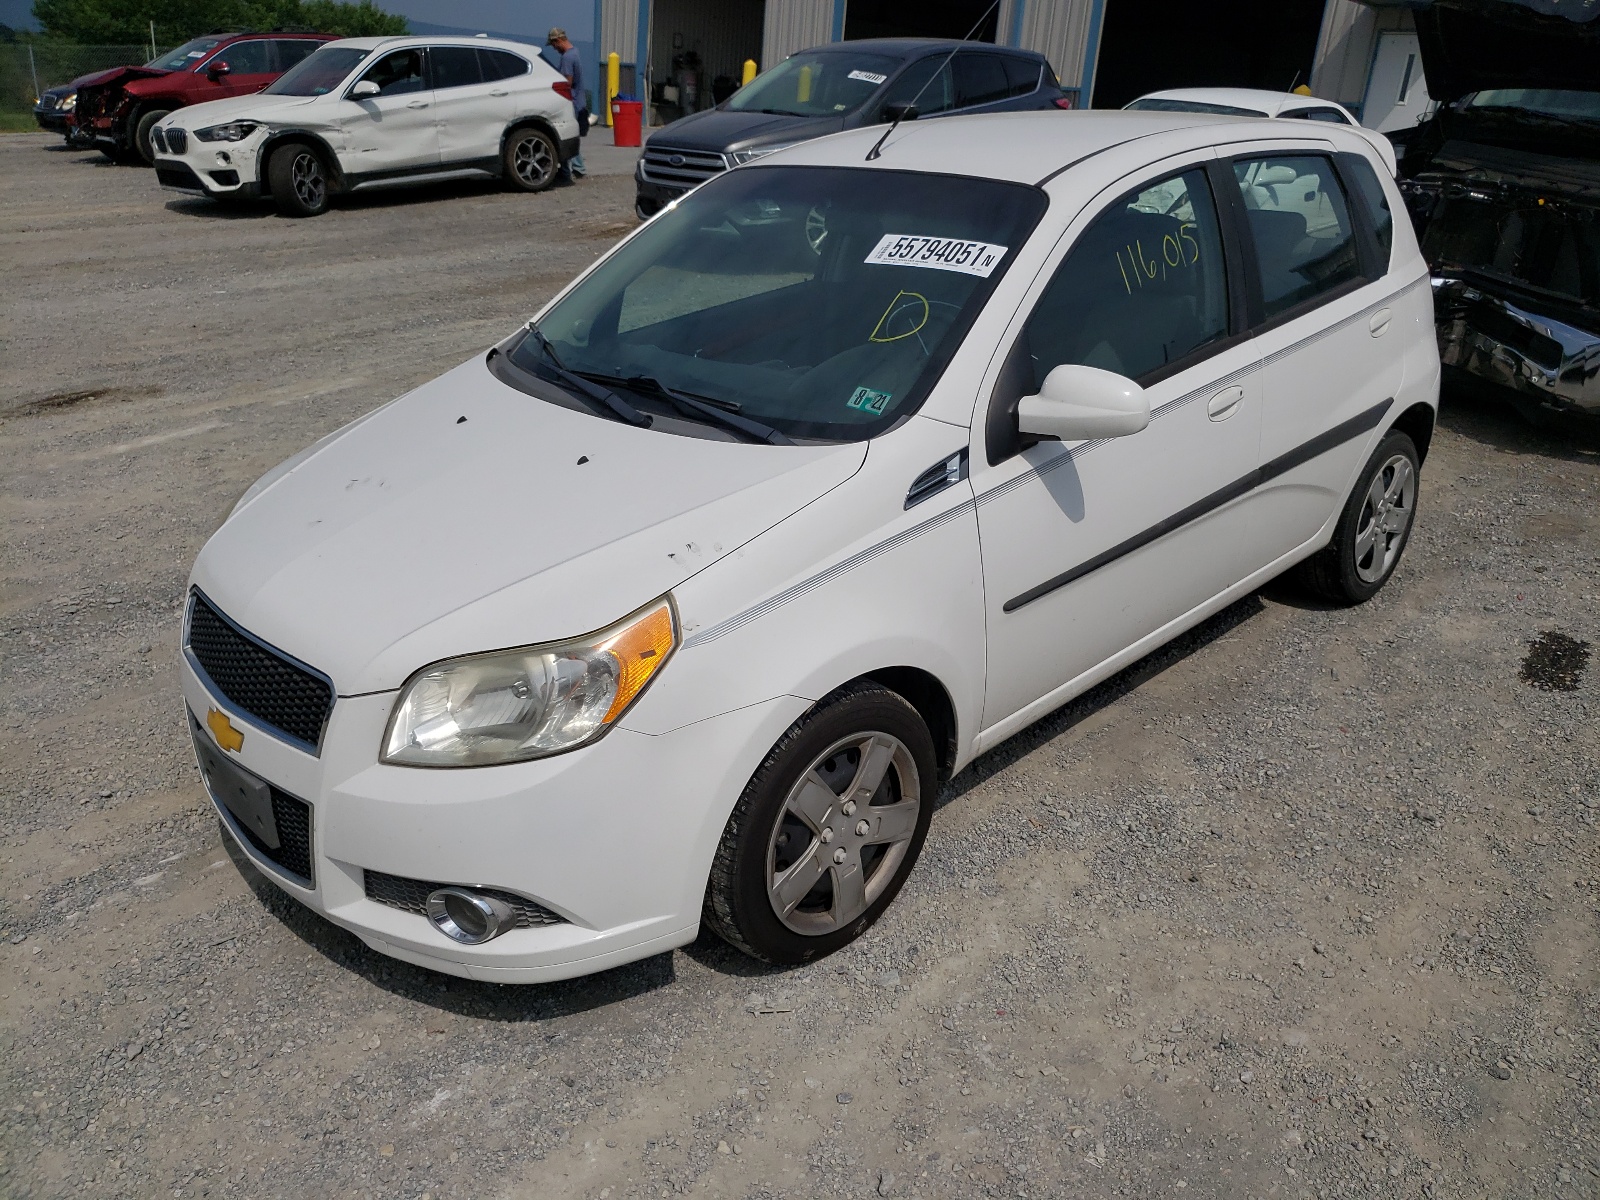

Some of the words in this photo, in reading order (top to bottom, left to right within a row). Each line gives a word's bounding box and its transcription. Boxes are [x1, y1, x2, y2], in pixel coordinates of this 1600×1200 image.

[888, 237, 987, 266] 55794051
[981, 255, 995, 267] N
[1116, 223, 1199, 295] 116,015
[868, 289, 930, 343] D
[853, 389, 867, 405] 8
[869, 393, 887, 410] 21
